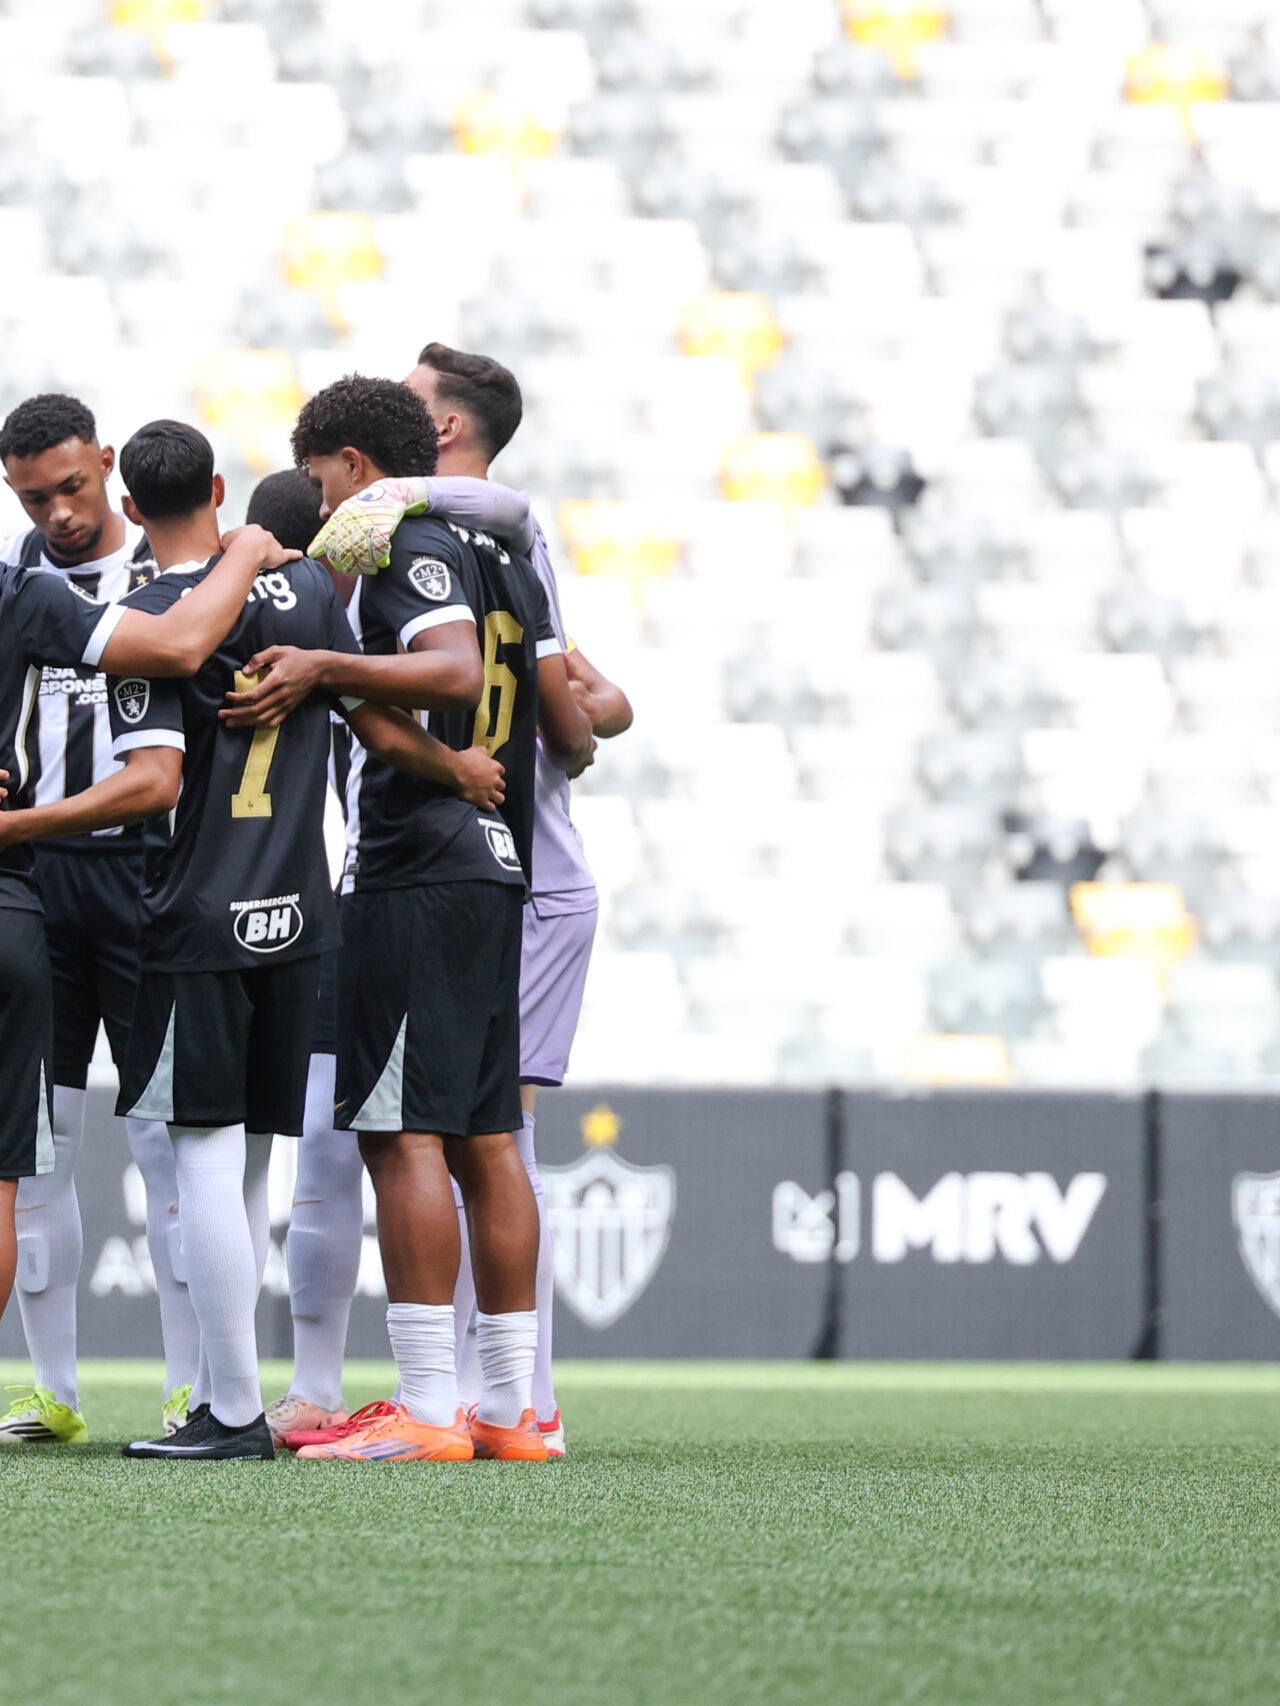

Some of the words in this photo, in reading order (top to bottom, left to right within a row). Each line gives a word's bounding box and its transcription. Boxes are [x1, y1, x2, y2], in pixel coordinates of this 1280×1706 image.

[246, 571, 298, 611] mg
[420, 565, 439, 578] M2
[123, 683, 140, 697] M2
[473, 610, 524, 757] 6
[232, 664, 278, 817] 7
[244, 906, 293, 943] BH
[871, 1170, 1108, 1266] MRV
